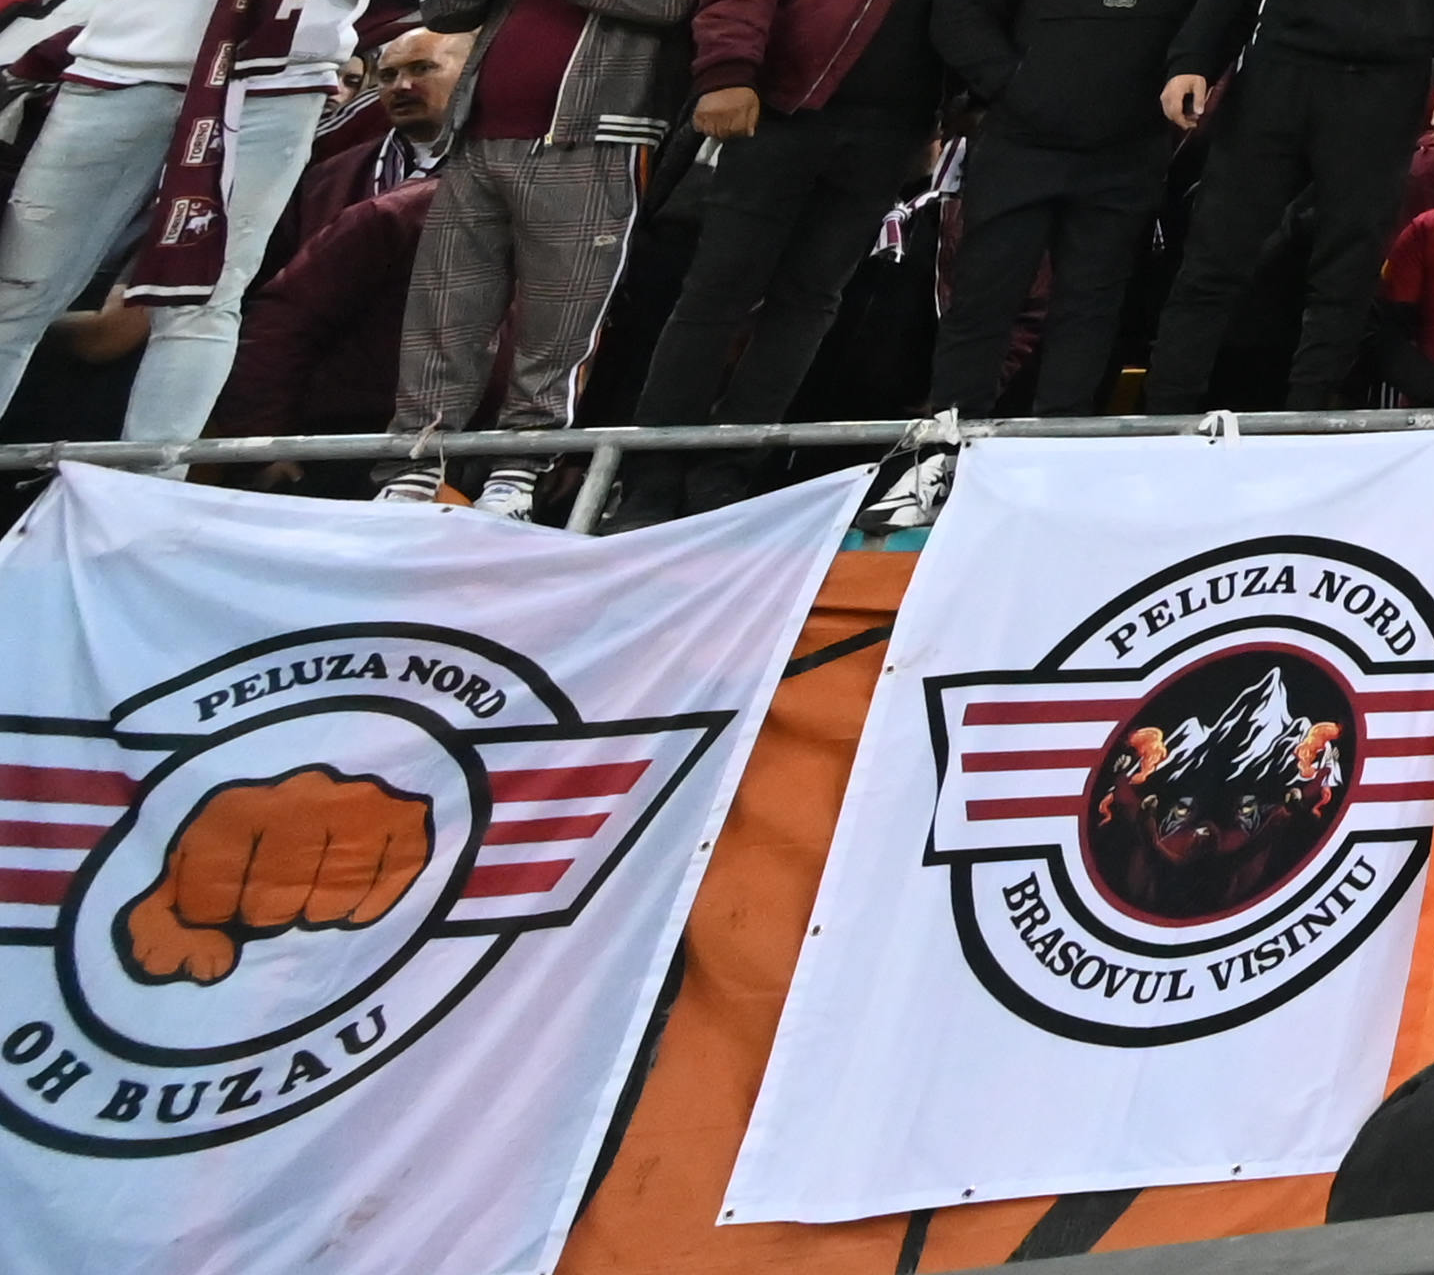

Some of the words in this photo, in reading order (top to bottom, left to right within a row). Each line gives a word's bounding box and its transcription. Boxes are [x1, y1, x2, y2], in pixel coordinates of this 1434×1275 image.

[163, 200, 187, 245] TORINO
[1104, 565, 1301, 660] PELUZA
[1308, 568, 1421, 659] NORD
[192, 652, 389, 723] PELUZA
[398, 654, 509, 720] NORD
[1000, 873, 1195, 1005] BRASOVUL
[1207, 855, 1381, 985] VISINIU
[96, 1004, 391, 1125] BUZAU
